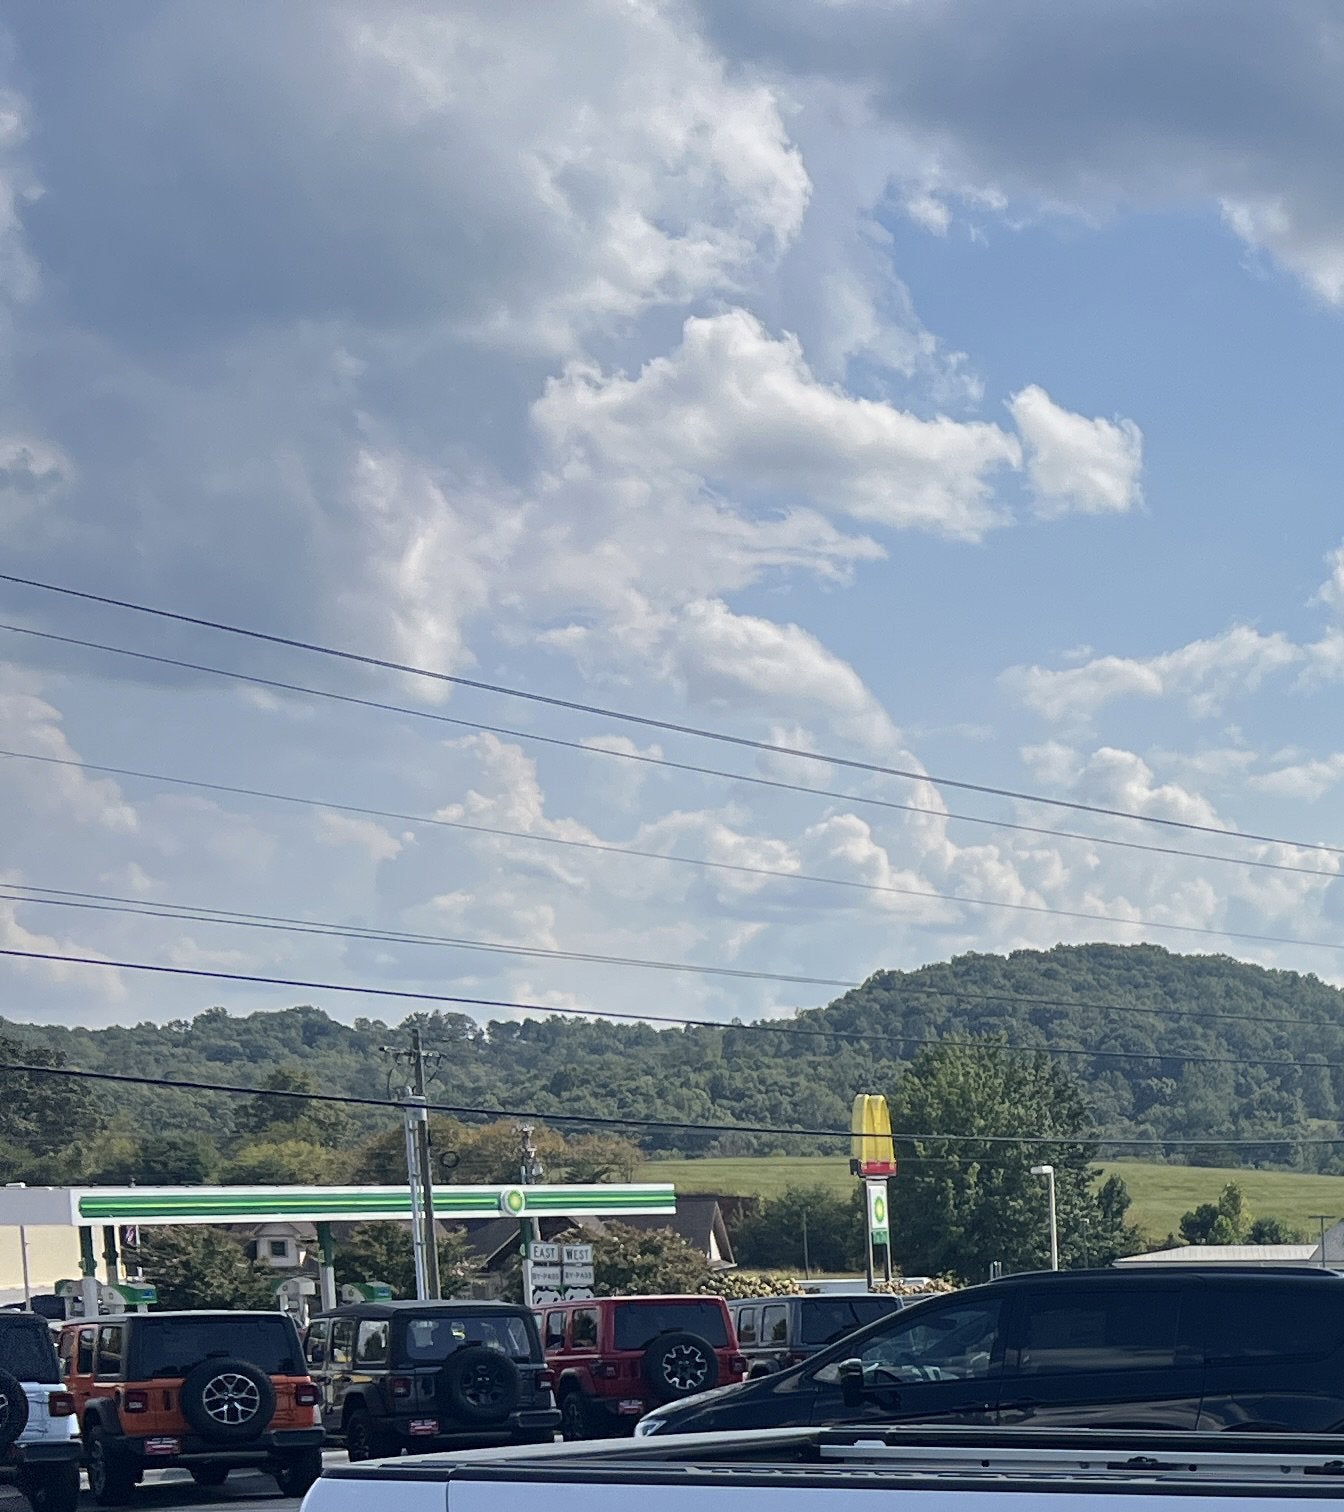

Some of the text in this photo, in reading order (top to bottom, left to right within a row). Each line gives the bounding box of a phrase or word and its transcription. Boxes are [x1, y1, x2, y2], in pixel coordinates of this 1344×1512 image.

[533, 1245, 555, 1259] EAST
[565, 1248, 590, 1260] WEST
[565, 1271, 592, 1279] BY-PASS
